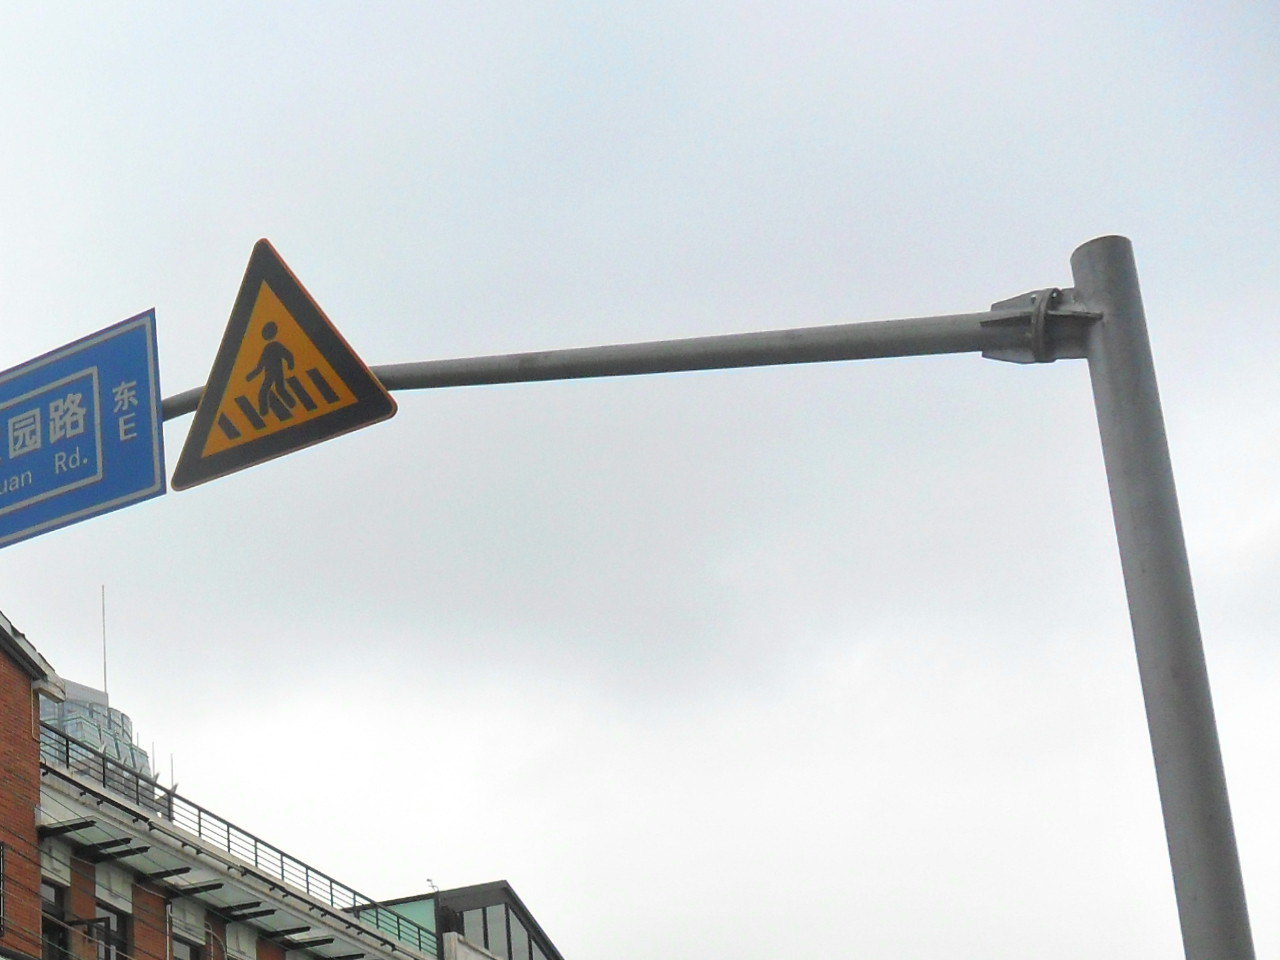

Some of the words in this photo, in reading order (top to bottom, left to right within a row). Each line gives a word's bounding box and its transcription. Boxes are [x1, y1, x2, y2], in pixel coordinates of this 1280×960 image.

[112, 380, 139, 413] 东
[119, 416, 138, 442] E
[53, 446, 88, 475] Rd.
